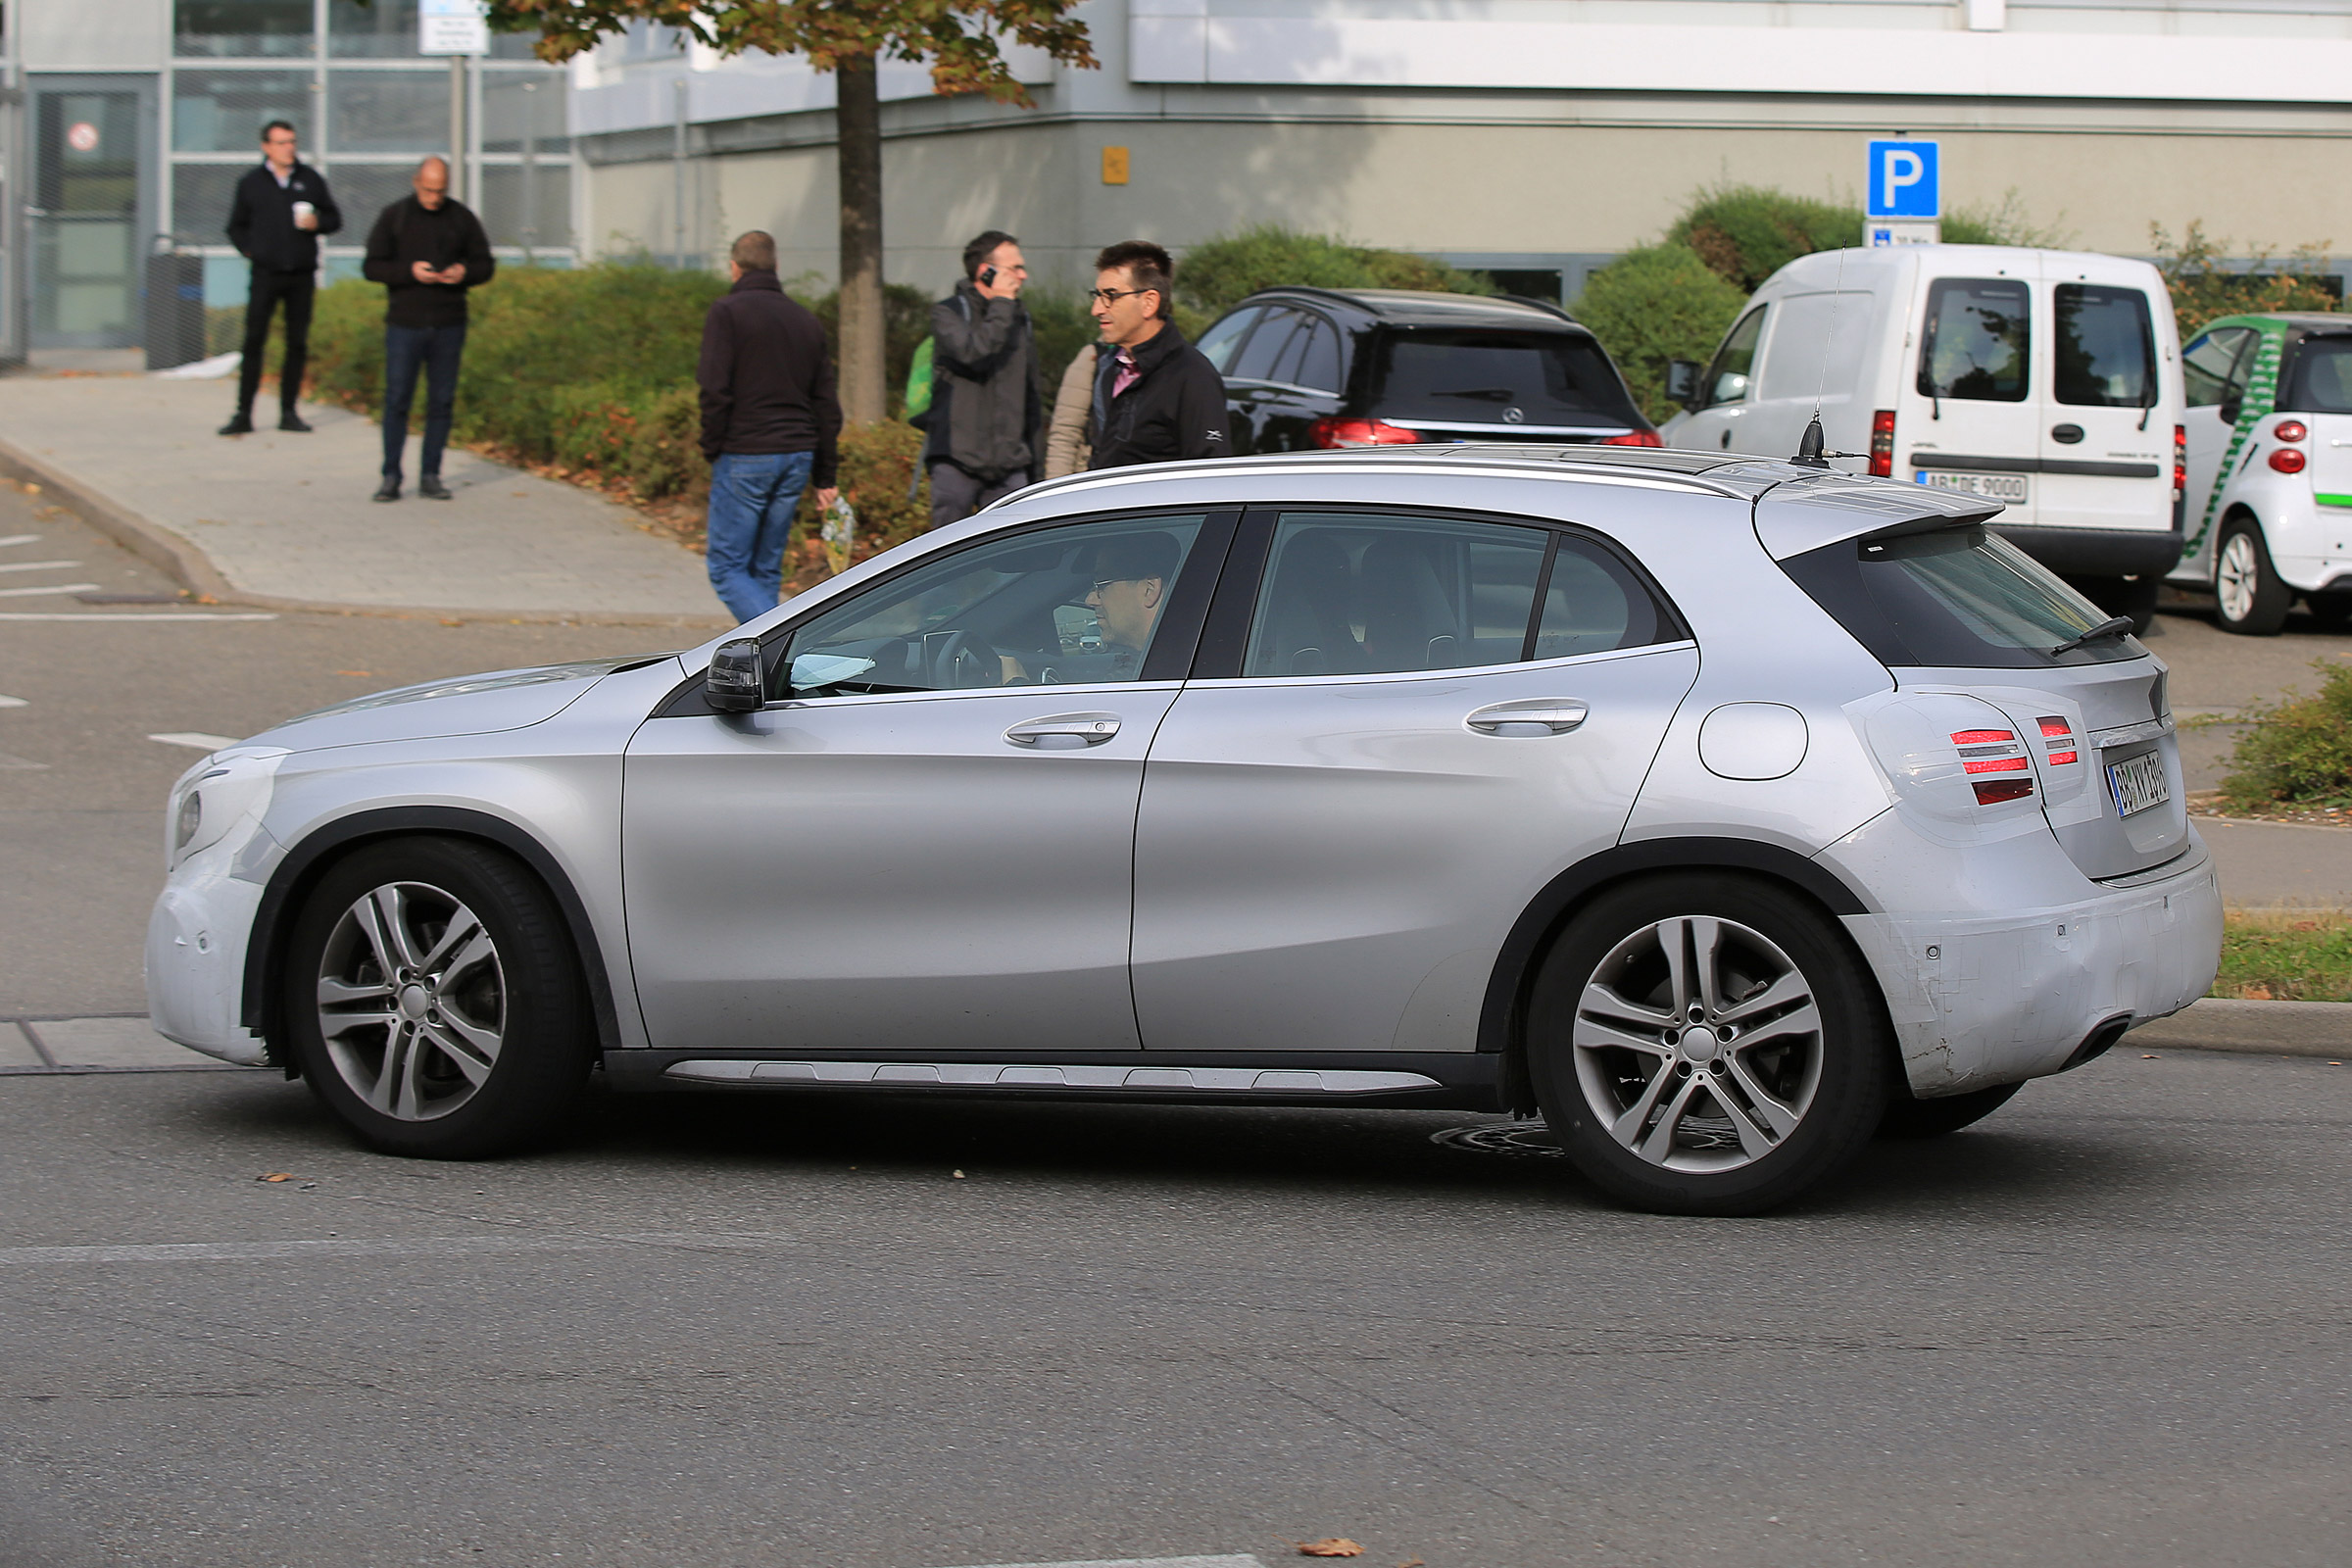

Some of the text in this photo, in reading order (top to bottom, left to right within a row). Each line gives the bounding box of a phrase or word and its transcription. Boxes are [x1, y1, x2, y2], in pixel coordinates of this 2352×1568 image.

[1884, 150, 1924, 208] P
[1984, 478, 2022, 497] 9000
[2116, 757, 2167, 809] BB XY 1396
